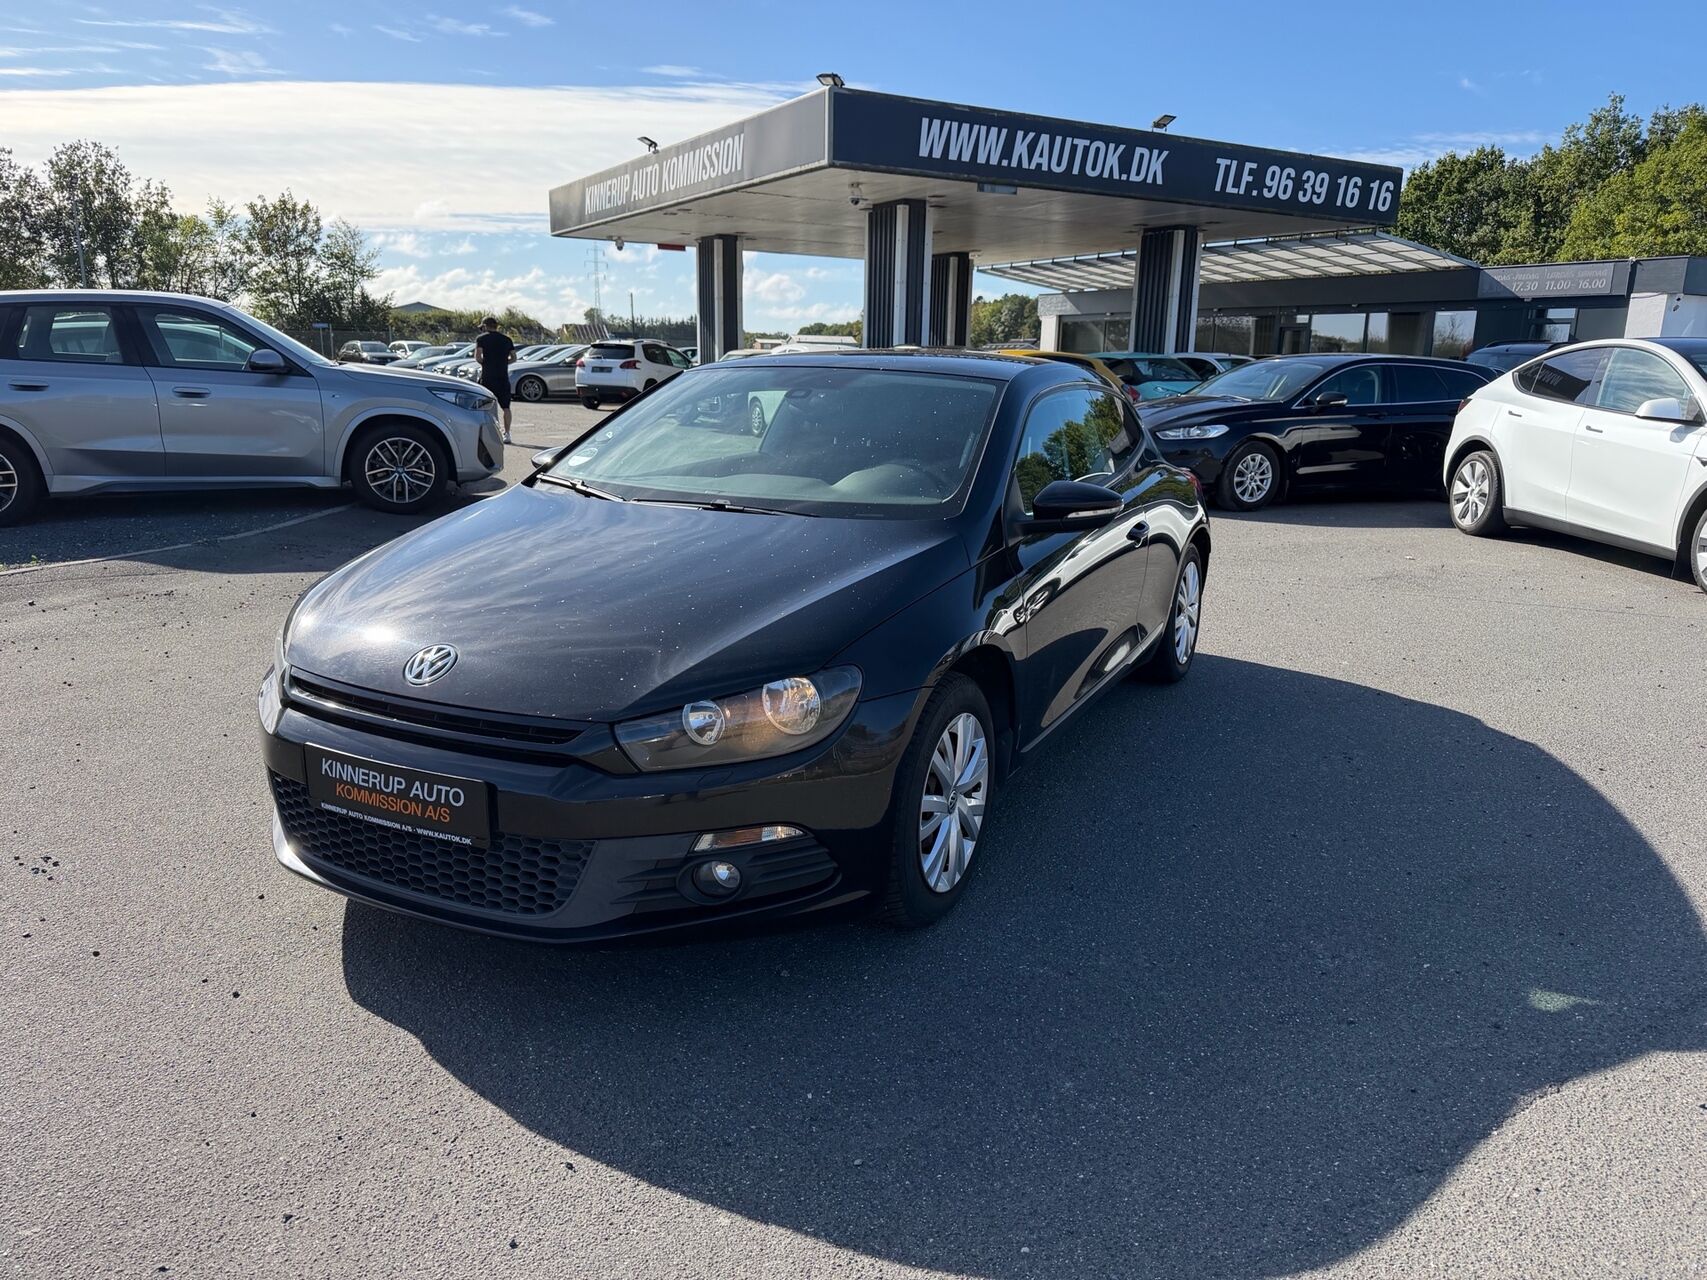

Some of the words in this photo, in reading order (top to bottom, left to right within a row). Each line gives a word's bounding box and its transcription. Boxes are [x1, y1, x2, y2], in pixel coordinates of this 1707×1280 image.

[584, 174, 630, 216] KINNERUP
[631, 163, 660, 201] AUTO
[661, 133, 745, 194] KOMMISSION
[918, 117, 1170, 185] WWW.KAUTOK.DK
[1214, 157, 1258, 196] TLF.
[1263, 165, 1296, 201] 96
[1298, 170, 1330, 205] 39
[1335, 175, 1363, 209] 16
[1368, 179, 1395, 212] 16
[1544, 280, 1571, 291] 11.00
[1578, 278, 1606, 289] 16.00
[321, 757, 406, 794] KINNERUP
[409, 781, 465, 807] AUTO
[335, 783, 422, 817] KOMMISSION
[424, 805, 451, 823] A/S
[348, 810, 364, 820] AUTO
[416, 827, 472, 846] WWW.KAUTOK.DK
